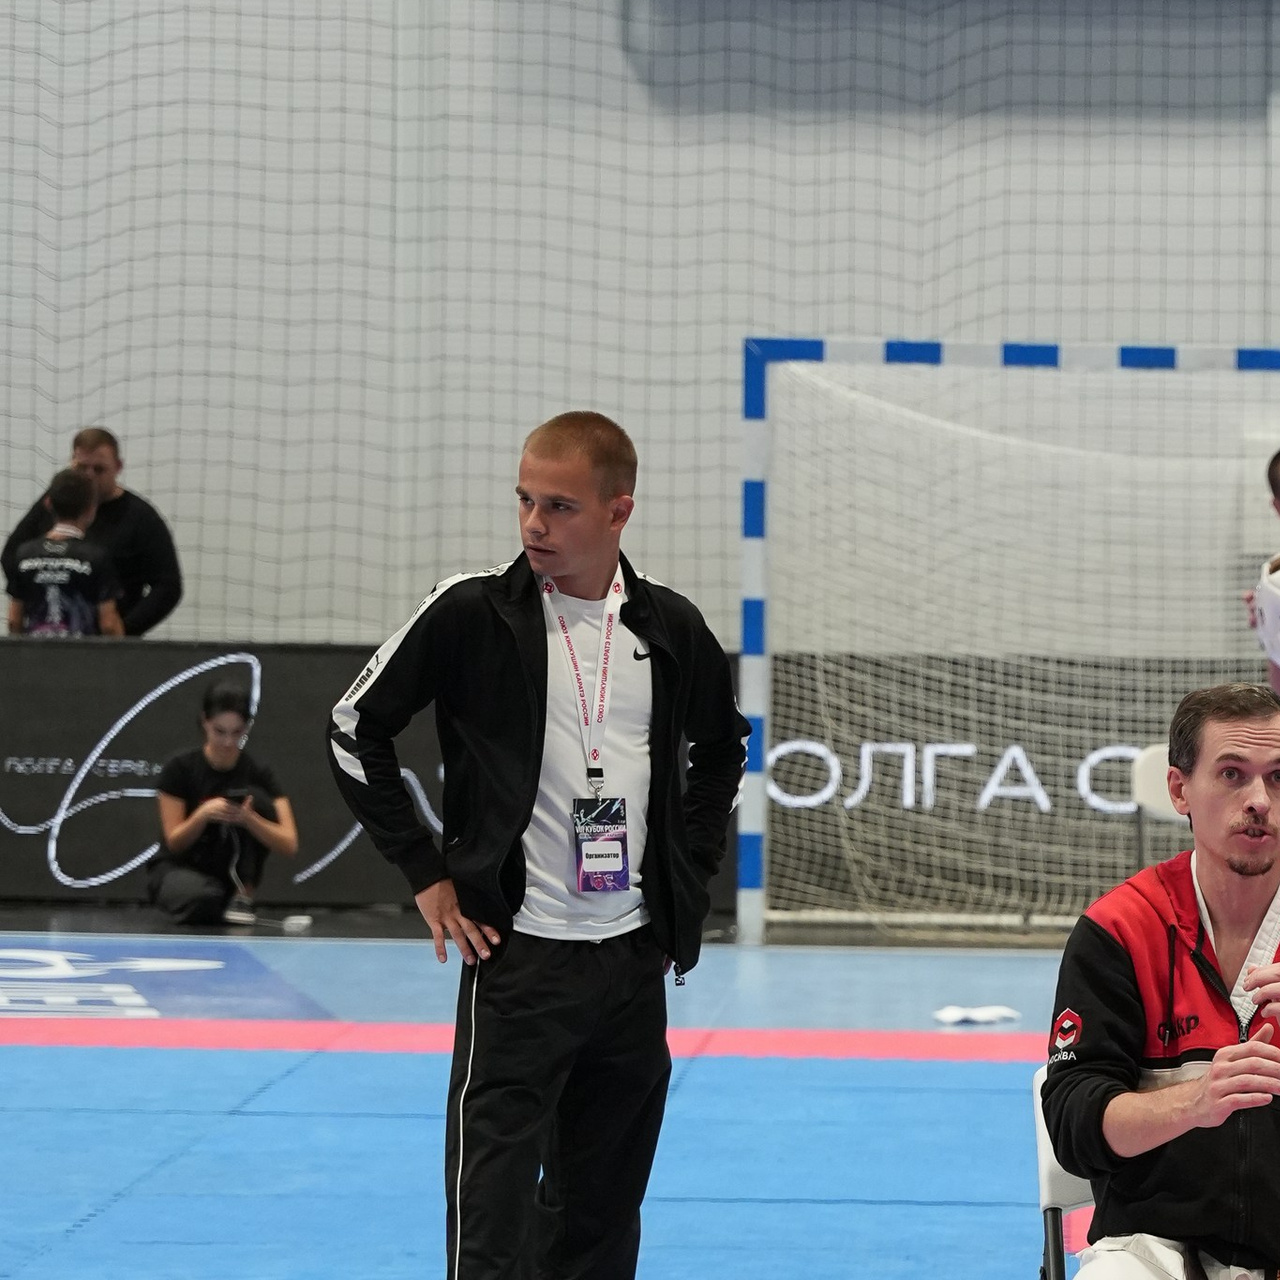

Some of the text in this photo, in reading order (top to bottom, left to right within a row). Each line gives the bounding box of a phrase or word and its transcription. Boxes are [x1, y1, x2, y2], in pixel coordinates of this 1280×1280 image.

[558, 615, 589, 726] СОЮЗ КИОКУШИН КАРАТЭ РОССИИ
[600, 666, 609, 703] КИОКУШИН
[597, 705, 605, 723] СОЮЗ
[1048, 1051, 1077, 1065] ОСКВА
